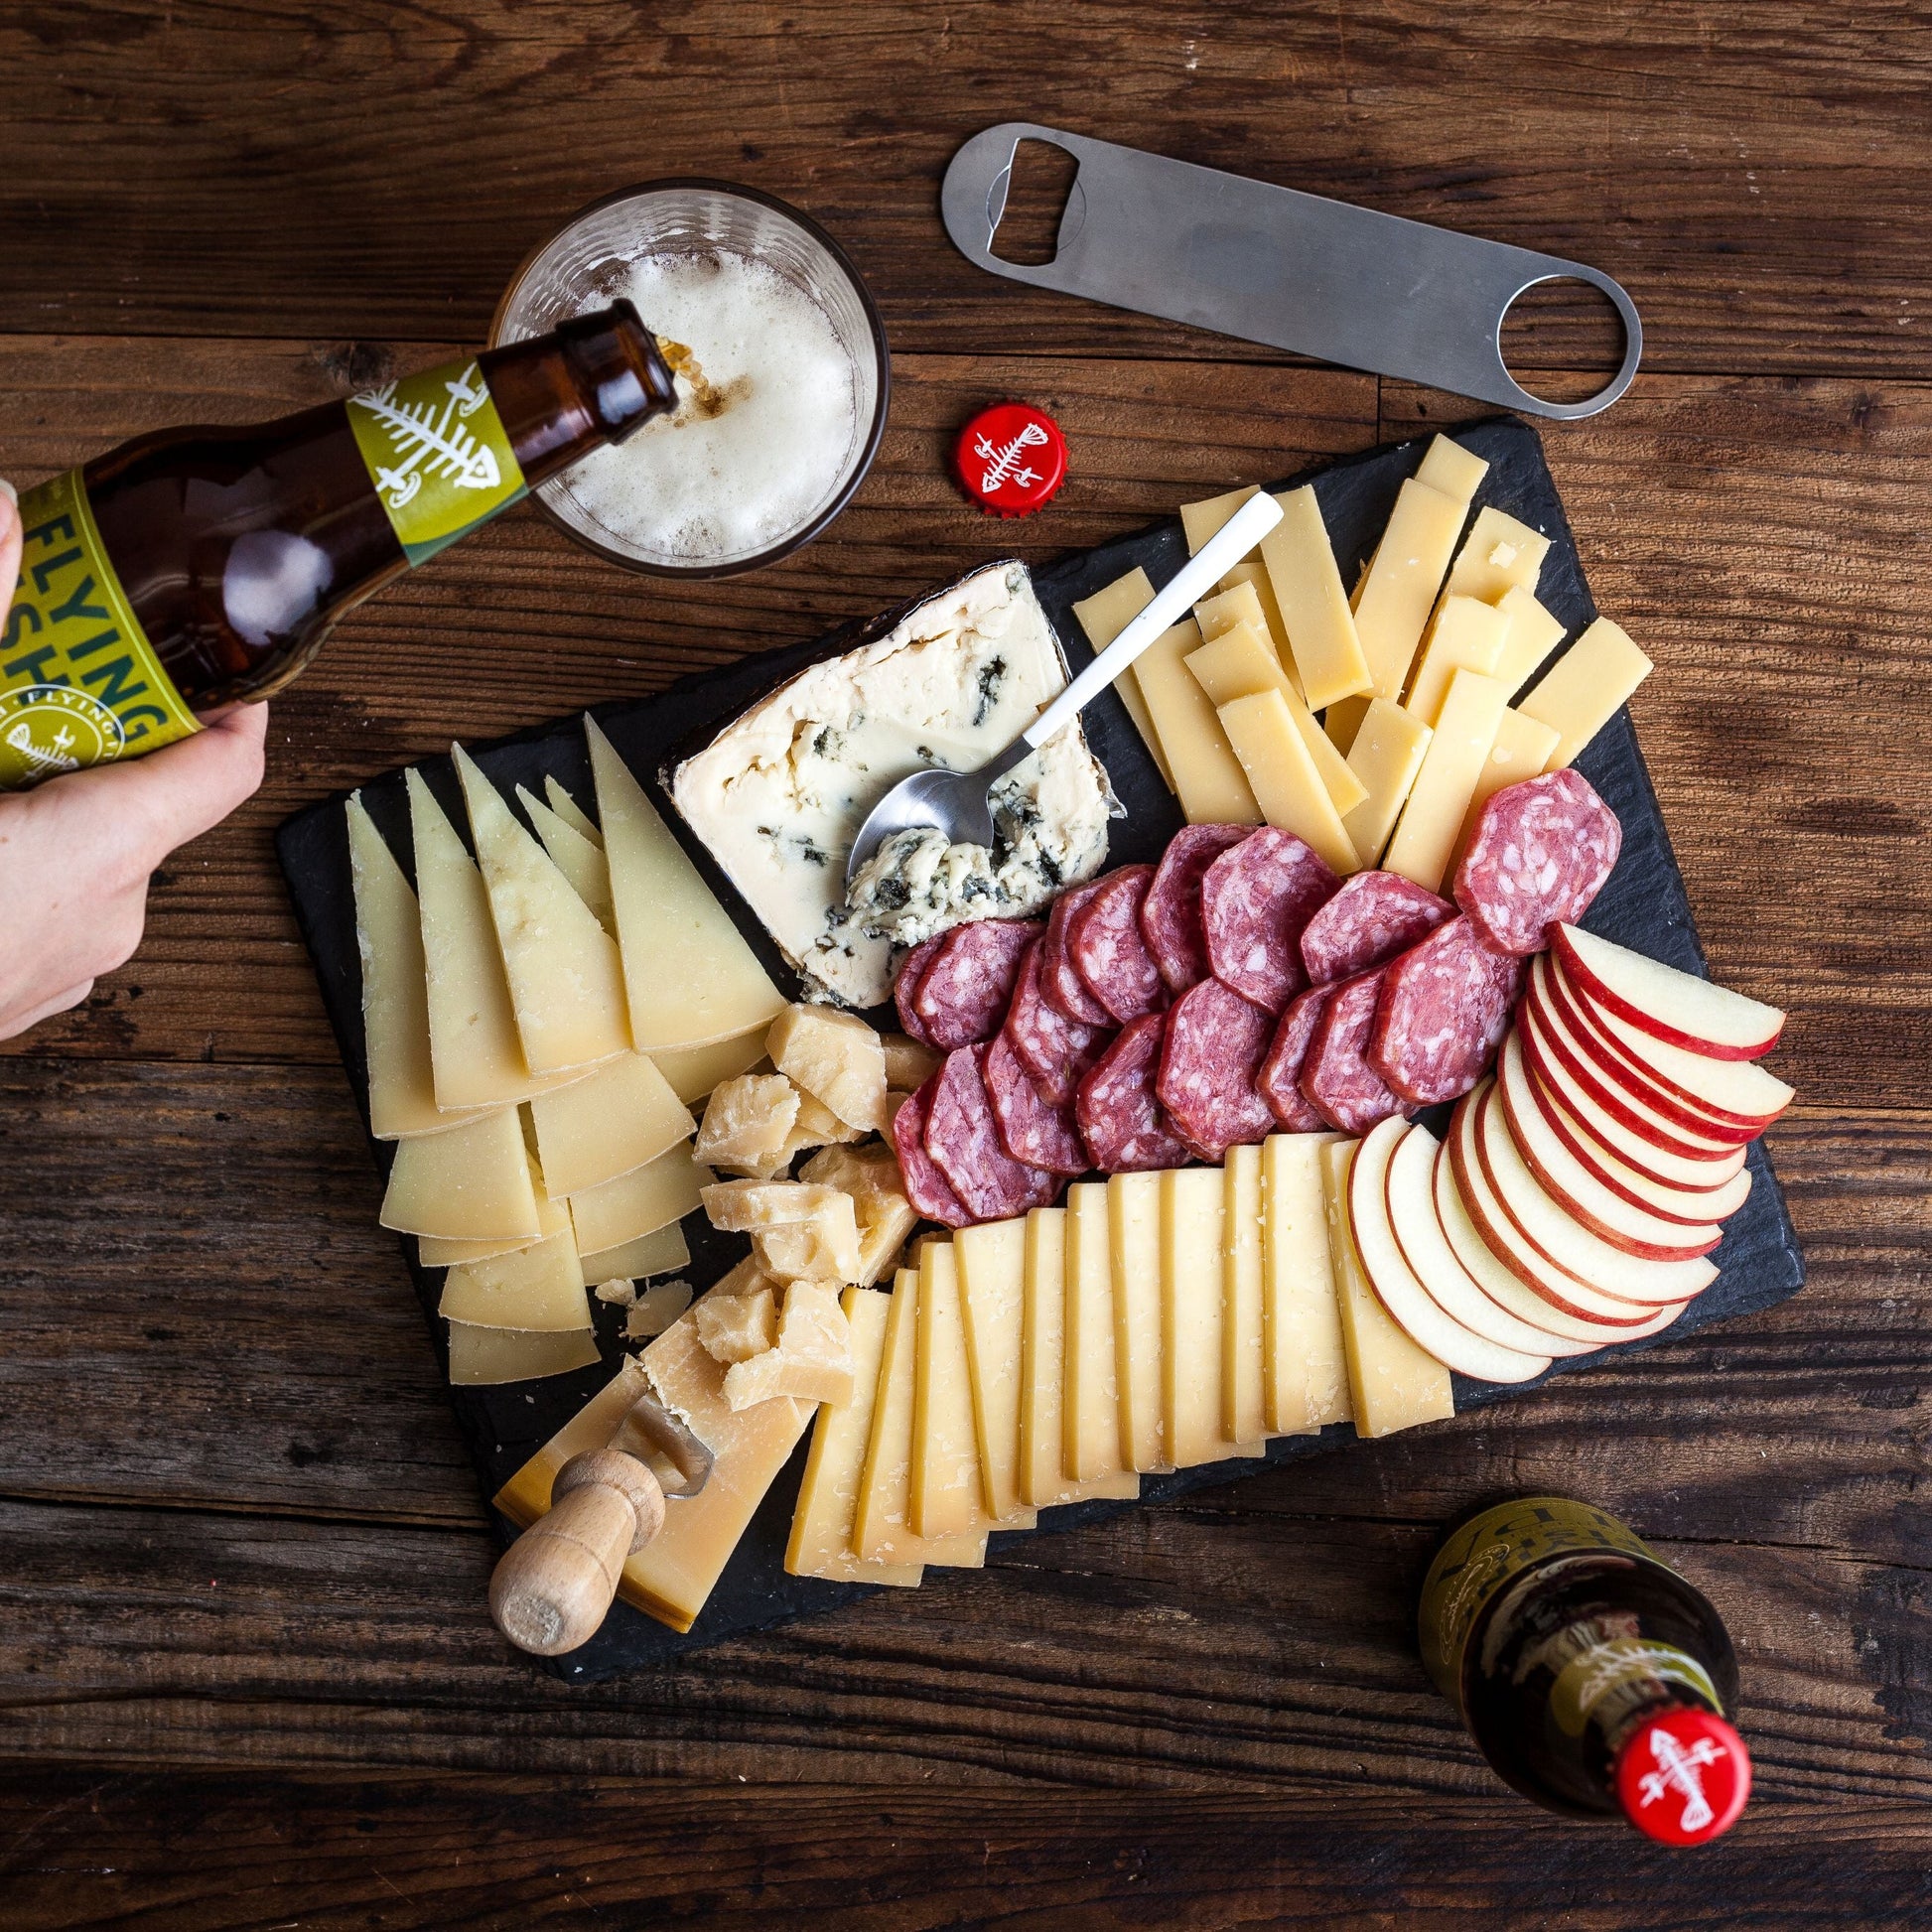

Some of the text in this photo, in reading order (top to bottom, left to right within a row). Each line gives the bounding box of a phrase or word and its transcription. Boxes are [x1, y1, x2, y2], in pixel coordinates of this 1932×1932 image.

[0, 574, 71, 706] SH
[23, 513, 168, 744] FLYING
[28, 691, 115, 734] FLYING
